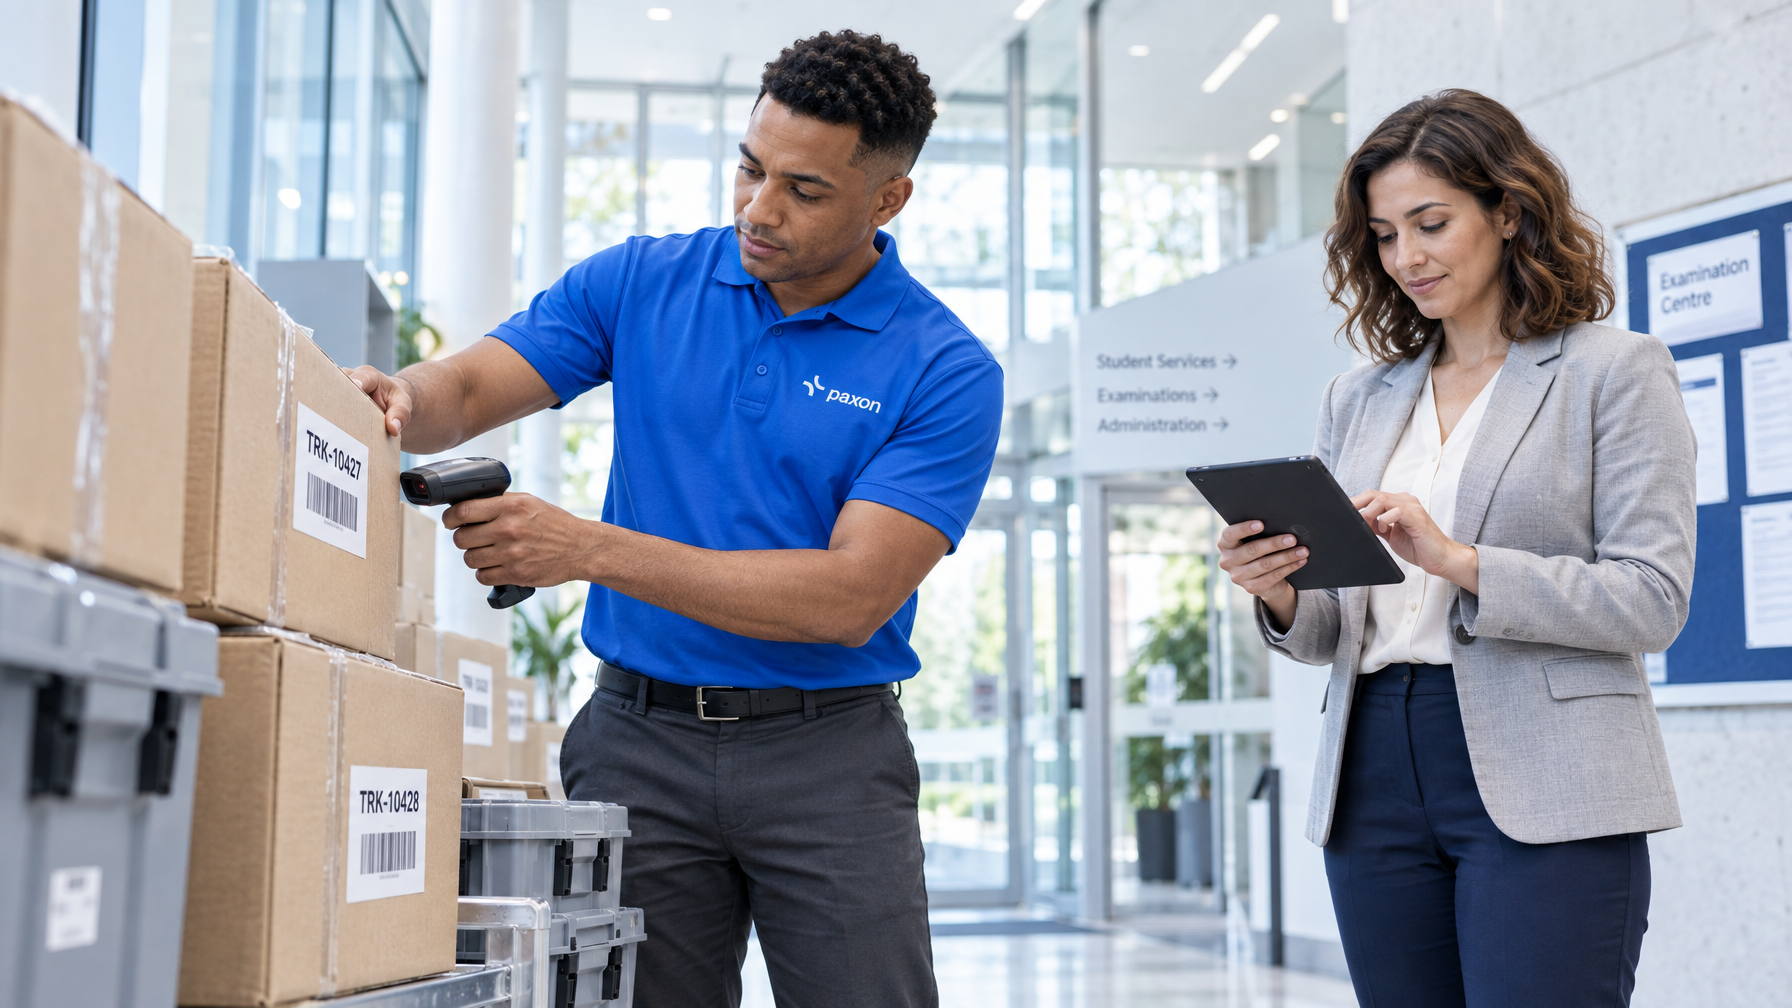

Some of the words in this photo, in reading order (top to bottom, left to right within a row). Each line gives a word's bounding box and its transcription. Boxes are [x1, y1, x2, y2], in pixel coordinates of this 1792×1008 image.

[1660, 258, 1749, 290] Examination
[1661, 289, 1712, 314] Centre
[1097, 353, 1152, 369] Student
[1157, 353, 1217, 369] Services
[825, 388, 882, 414] paxon
[1097, 387, 1197, 403] Examinations
[1097, 417, 1207, 433] Administration
[306, 429, 361, 480] TRK-10427
[359, 790, 420, 814] TRK-10428
